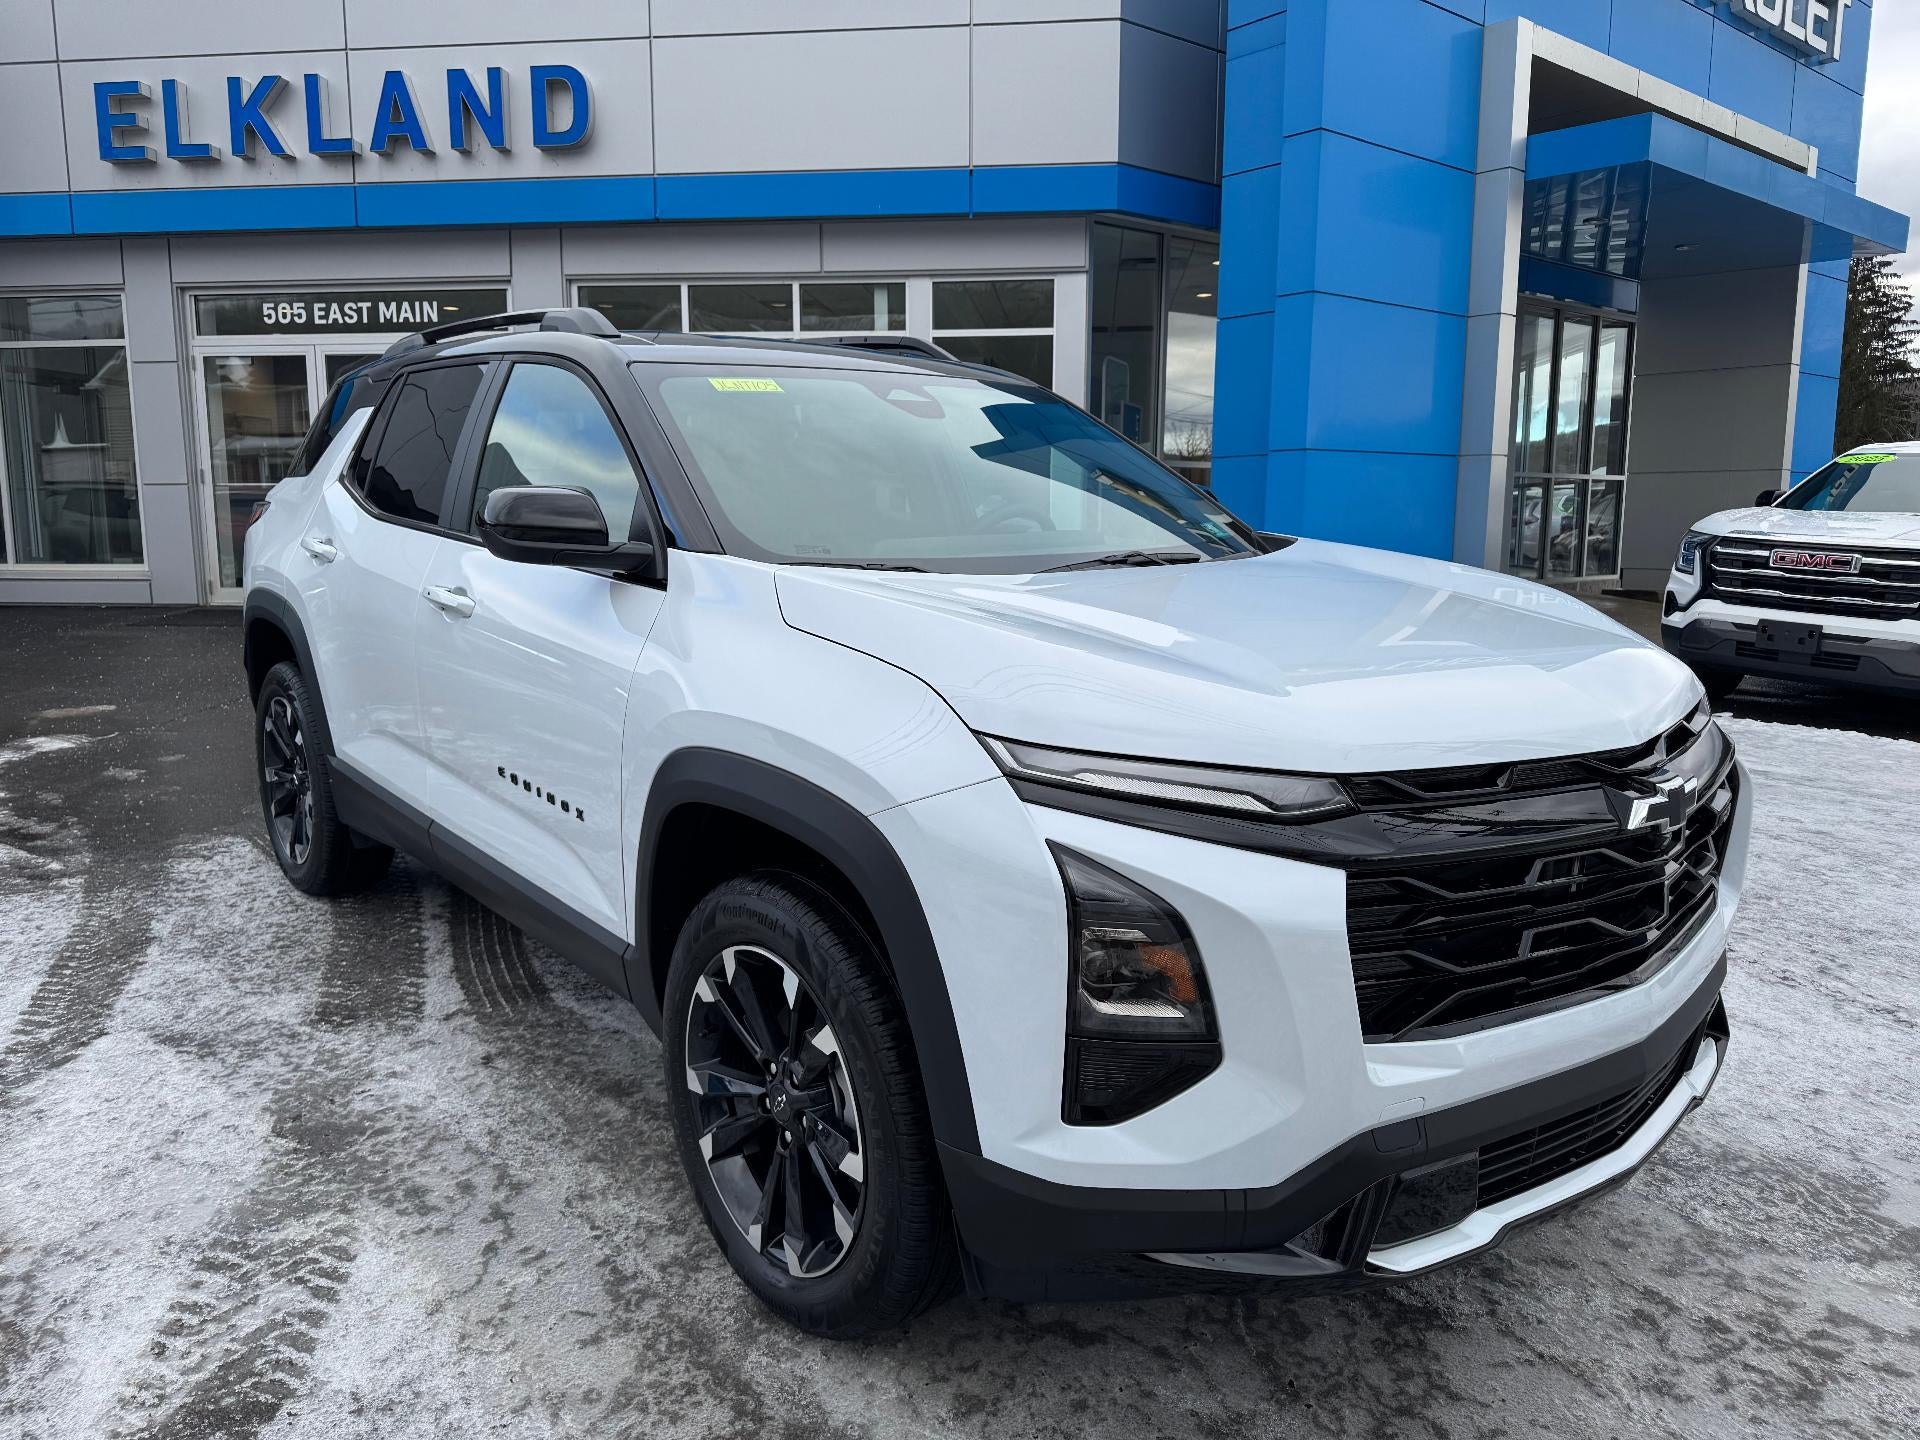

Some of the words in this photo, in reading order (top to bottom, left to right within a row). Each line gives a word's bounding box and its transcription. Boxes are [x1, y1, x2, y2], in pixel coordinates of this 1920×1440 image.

[94, 65, 594, 163] ELKLAND
[313, 302, 371, 325] EAST
[378, 301, 439, 324] MAIN
[1773, 551, 1854, 571] GMC
[497, 765, 585, 822] EQUINOX
